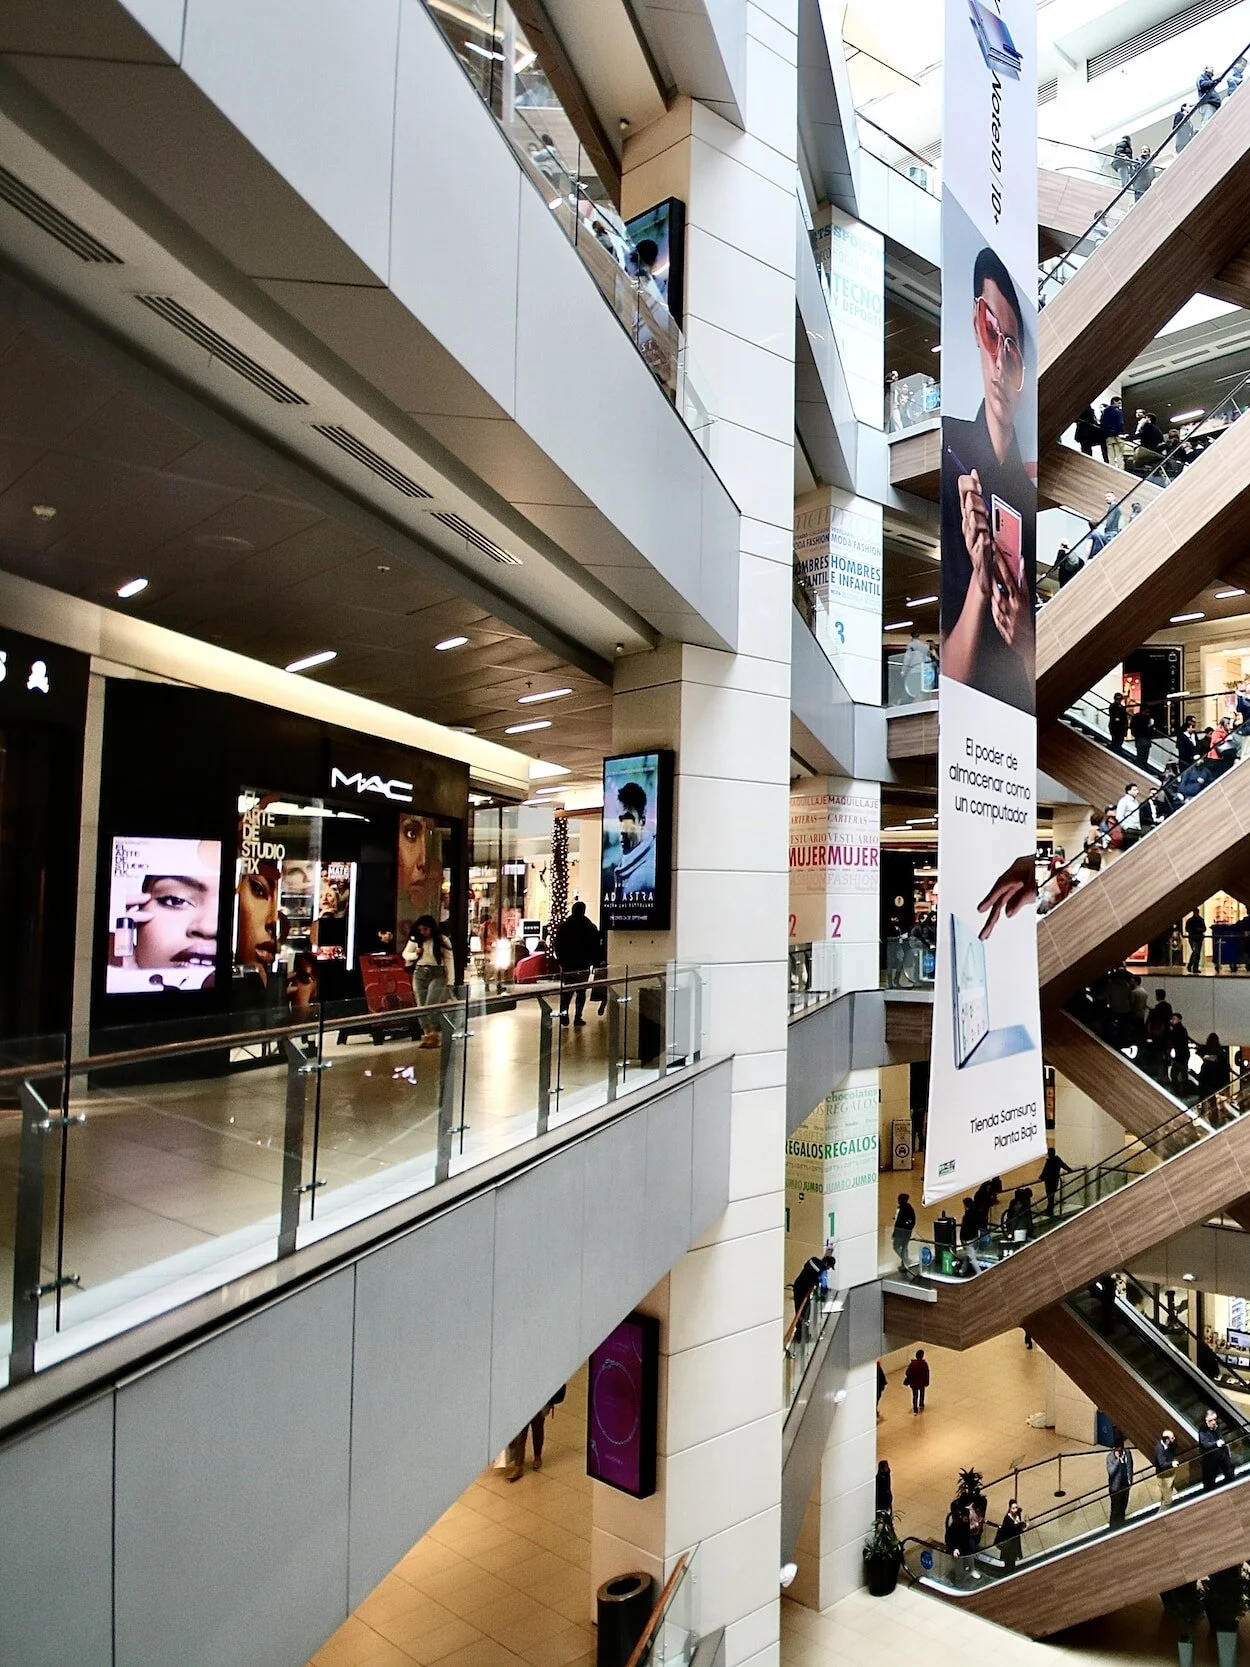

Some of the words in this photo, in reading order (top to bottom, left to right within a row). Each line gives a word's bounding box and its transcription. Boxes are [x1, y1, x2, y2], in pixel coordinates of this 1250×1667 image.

[833, 272, 882, 314] TECNO
[806, 533, 830, 547] FASHION
[831, 533, 853, 549] MODA
[853, 540, 882, 557] FASHION
[831, 555, 881, 582] HOMBRES
[831, 571, 836, 583] E
[839, 573, 881, 596] INFANTIL
[835, 621, 845, 645] 3
[966, 737, 973, 756] El
[975, 744, 1004, 766] poder
[1006, 752, 1018, 771] de
[949, 762, 1004, 793] almacenar
[1005, 781, 1031, 801] como
[828, 795, 879, 809] MAQUILLAJE
[955, 795, 968, 814] un
[970, 799, 1028, 825] computador
[243, 810, 275, 827] ARTE
[828, 813, 868, 825] CARTERAS
[243, 824, 259, 841] DE
[828, 832, 878, 845] VESTUARIO
[241, 841, 285, 860] STUDIO
[828, 845, 878, 867] MUJER
[242, 858, 259, 875] FIX
[828, 873, 878, 886] FASHION
[604, 892, 616, 901] AD
[622, 891, 654, 901] ASTRA
[789, 914, 797, 937] 2
[831, 914, 841, 938] 2
[826, 1088, 878, 1103] chocolates
[826, 1098, 878, 1116] REGALOS
[970, 1113, 999, 1134] Tienda
[1000, 1101, 1037, 1124] Samsung
[994, 1131, 1020, 1150] Planta
[1021, 1122, 1038, 1141] Baja
[824, 1135, 877, 1160] REGALOS
[803, 1181, 824, 1193] JUMBO
[852, 1172, 877, 1187] JUMBO
[828, 1212, 835, 1237] 1
